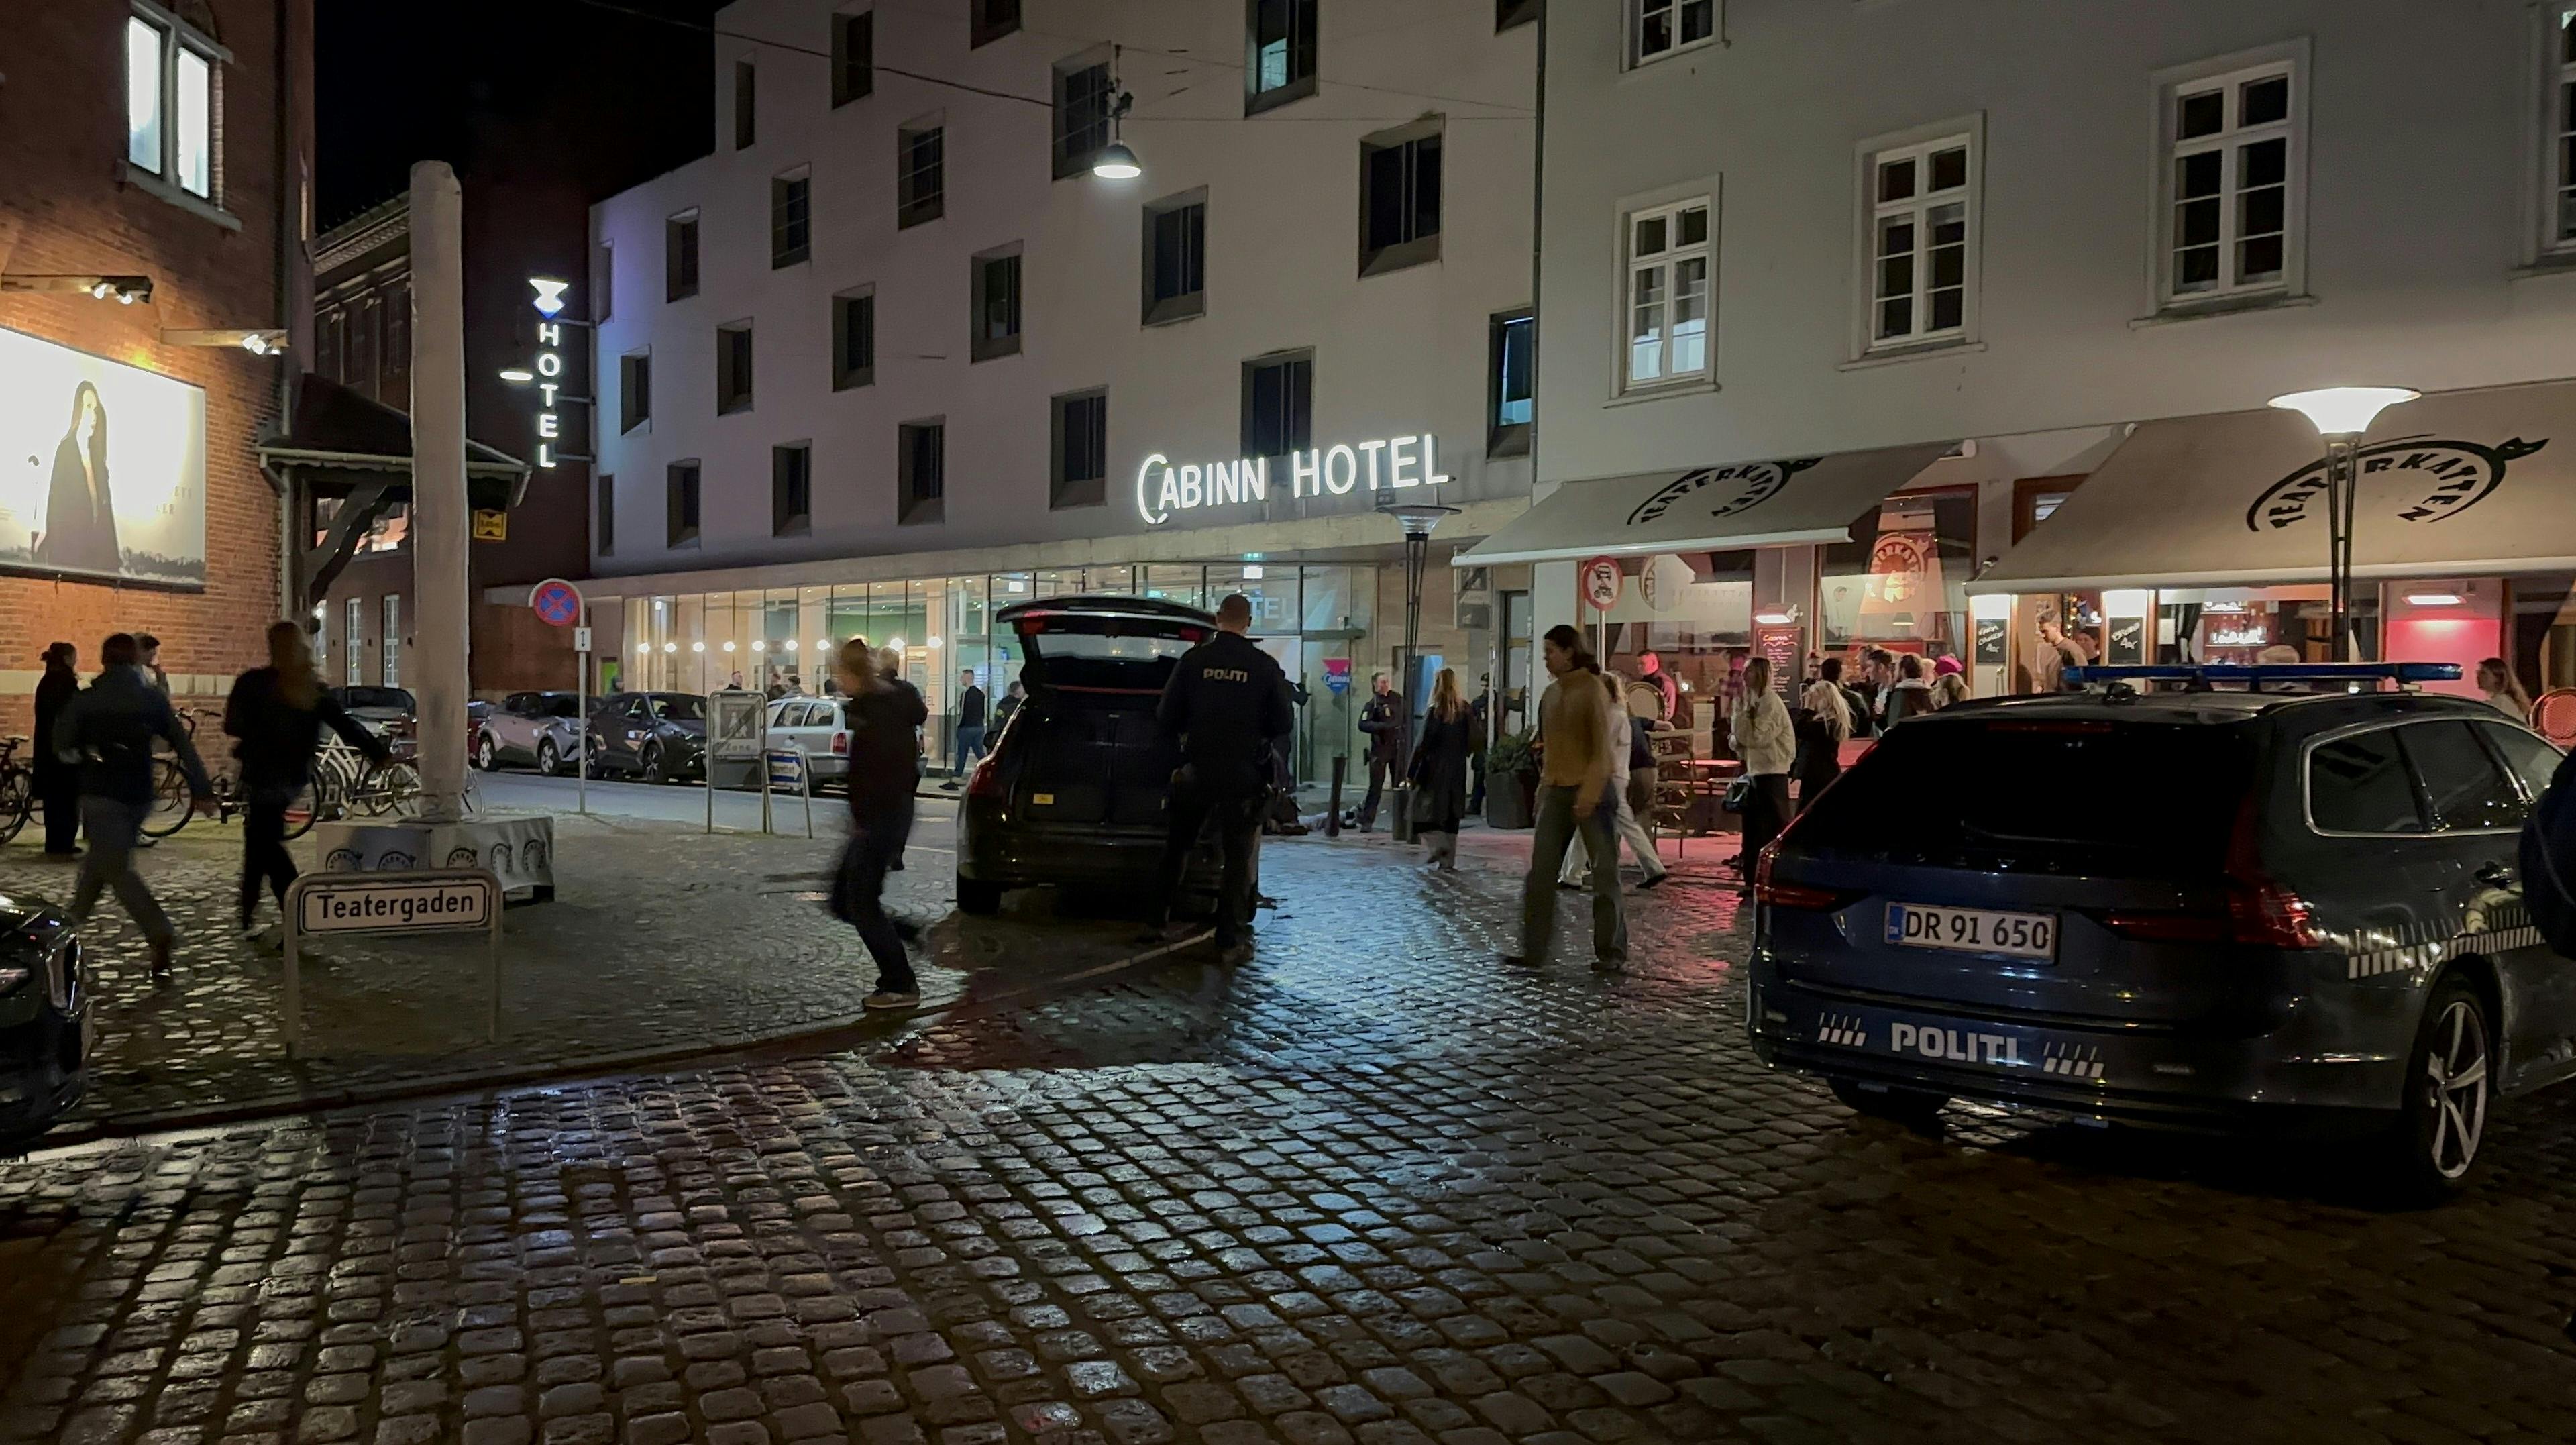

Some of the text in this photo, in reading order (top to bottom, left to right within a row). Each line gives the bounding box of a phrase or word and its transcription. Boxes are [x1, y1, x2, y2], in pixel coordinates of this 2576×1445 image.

[537, 322, 561, 469] HOTEL
[1137, 433, 1450, 525] CABINN HOTEL
[1203, 667, 1248, 683] POLITI
[317, 890, 474, 922] Teatergaden
[1904, 910, 1941, 941] DR
[1950, 914, 1981, 945] 91
[1992, 917, 2049, 950] 650
[1890, 1022, 2019, 1068] POLITI
